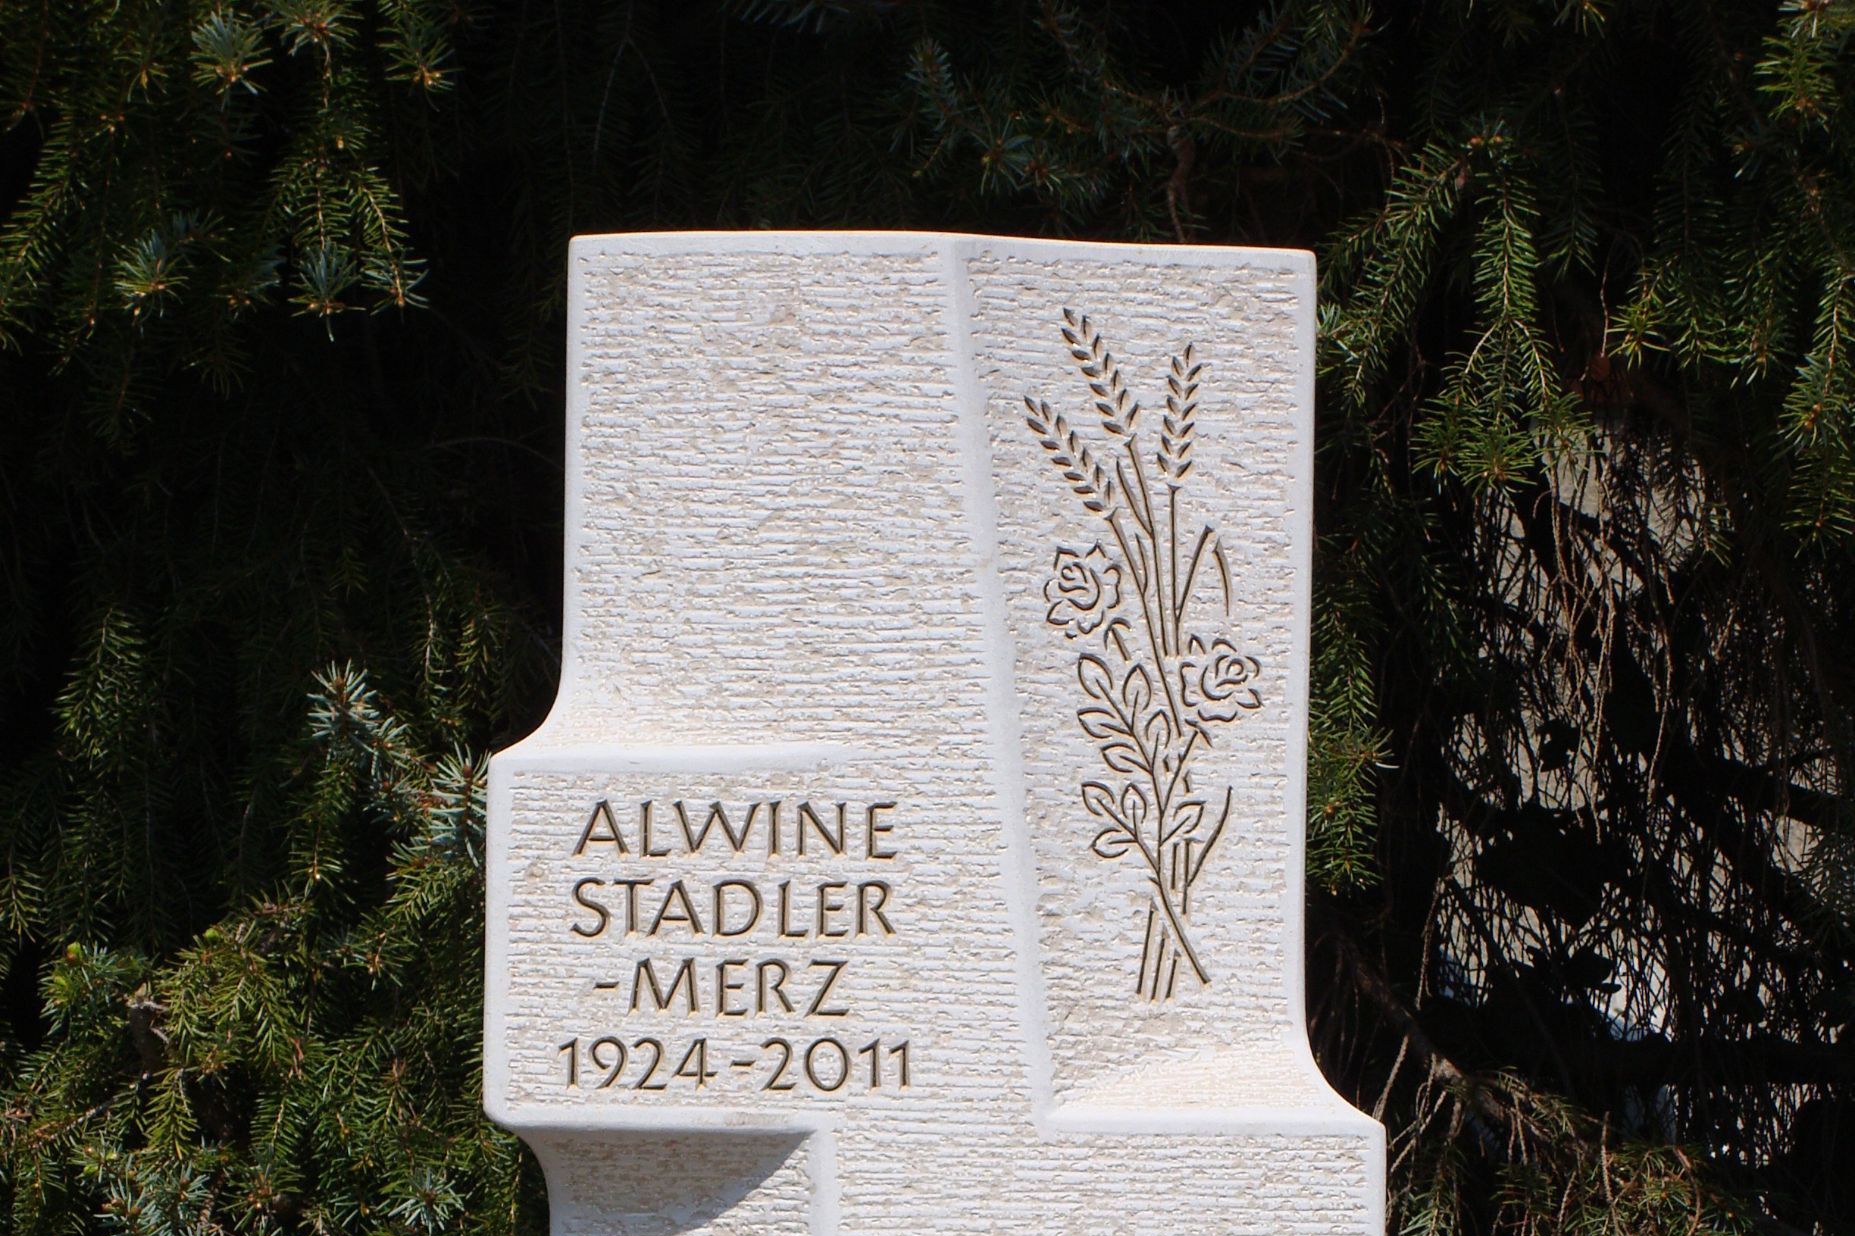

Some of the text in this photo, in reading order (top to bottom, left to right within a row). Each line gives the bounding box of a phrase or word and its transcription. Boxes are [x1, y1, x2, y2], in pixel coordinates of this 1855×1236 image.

[572, 799, 898, 860] ALWINE
[570, 876, 898, 938] STADLER
[593, 957, 851, 1017] -MERZ
